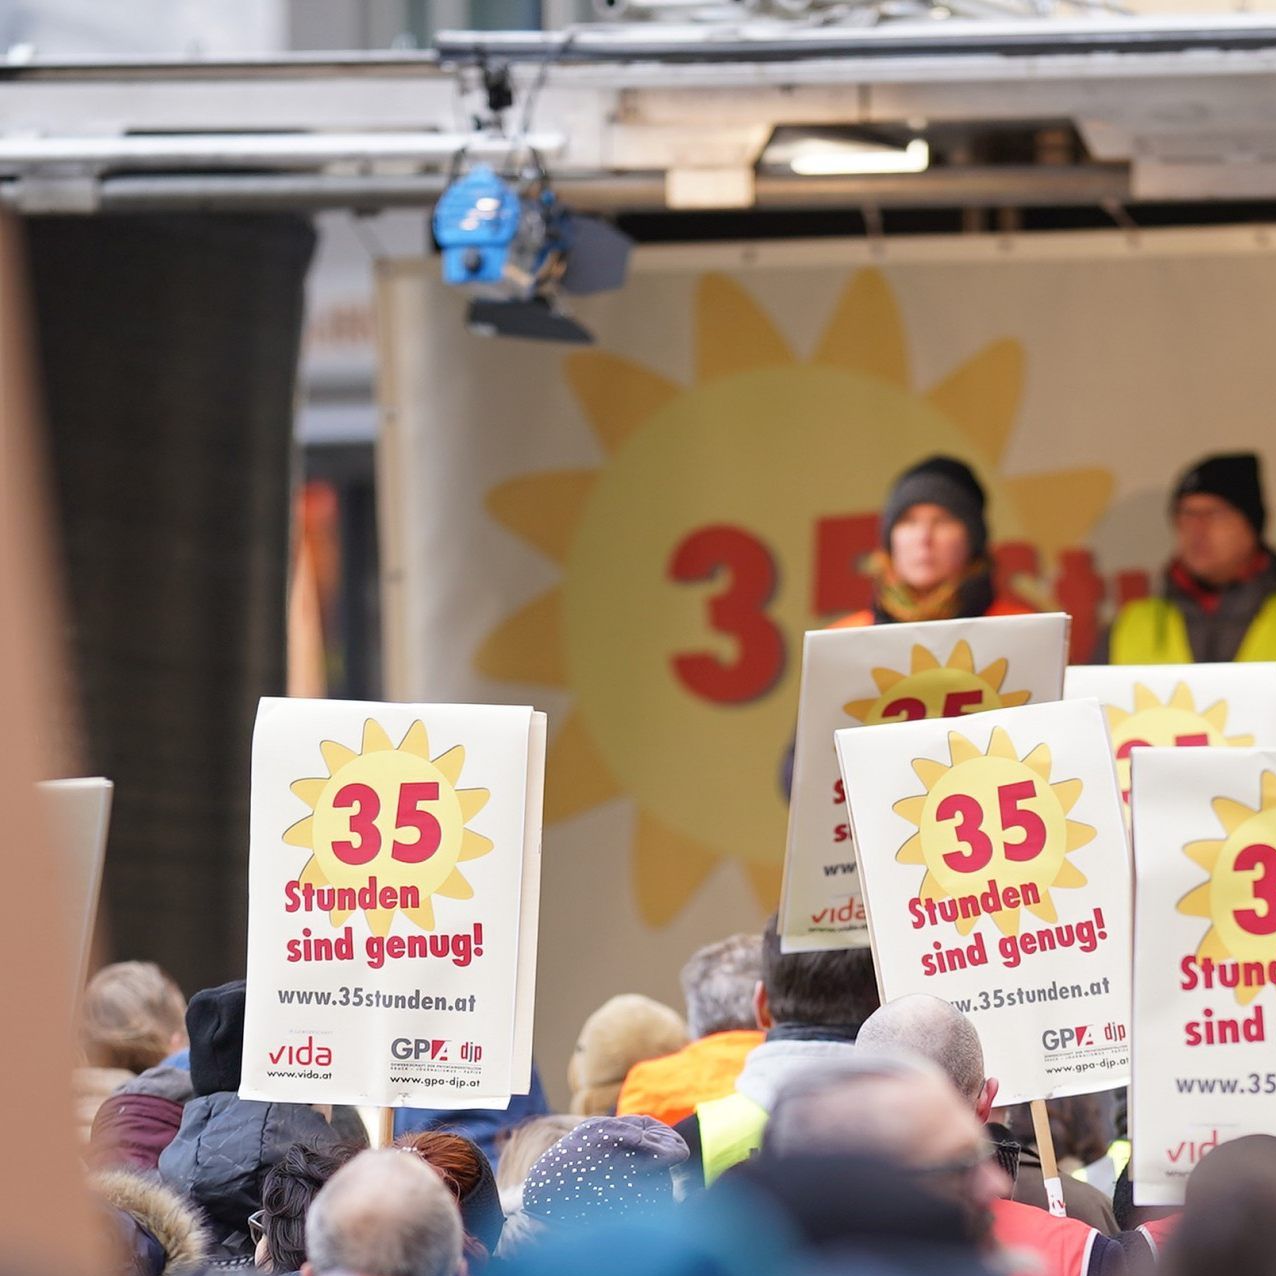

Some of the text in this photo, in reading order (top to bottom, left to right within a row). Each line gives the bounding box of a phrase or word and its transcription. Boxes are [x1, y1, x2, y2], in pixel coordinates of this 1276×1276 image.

[331, 781, 442, 866] 35
[935, 779, 1047, 874] 35
[284, 876, 420, 913] Stunden
[908, 879, 1040, 929] Stunden
[287, 922, 483, 969] sind genug!
[921, 908, 1108, 976] sind genug!
[277, 986, 477, 1013] www.35stunden.at
[1104, 1021, 1127, 1042] djp
[1184, 1004, 1265, 1047] sind
[268, 1036, 332, 1067] vida
[460, 1041, 483, 1063] djp
[266, 1070, 481, 1088] www.vida.at www.gpa-djp.at
[1167, 1130, 1217, 1163] vid
